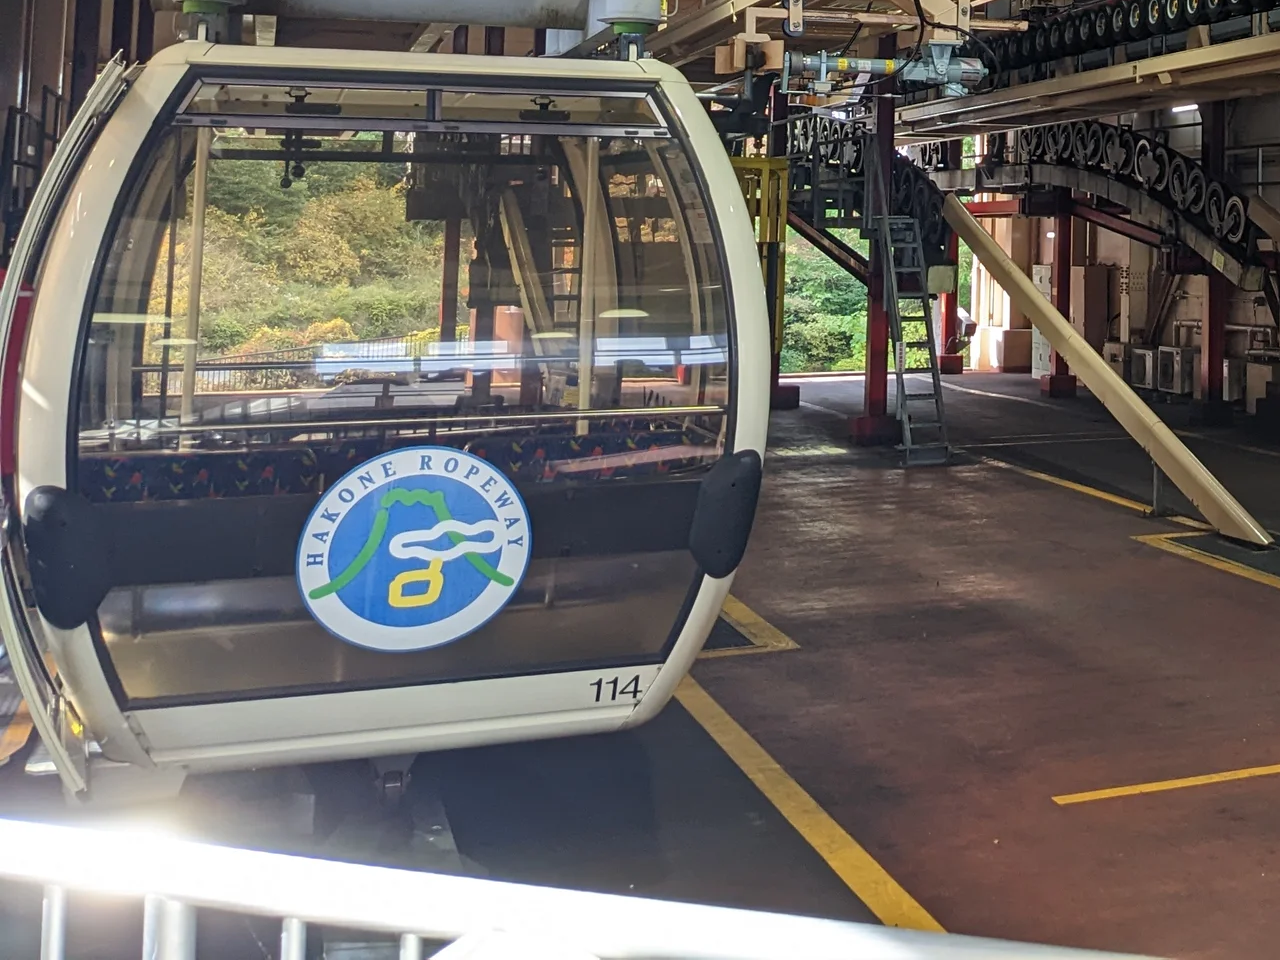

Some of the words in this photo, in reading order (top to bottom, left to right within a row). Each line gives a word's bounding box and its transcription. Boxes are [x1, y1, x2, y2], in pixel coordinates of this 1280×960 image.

[306, 461, 396, 567] HAKONE
[419, 454, 524, 548] ROPEWAY
[589, 674, 643, 702] 114
